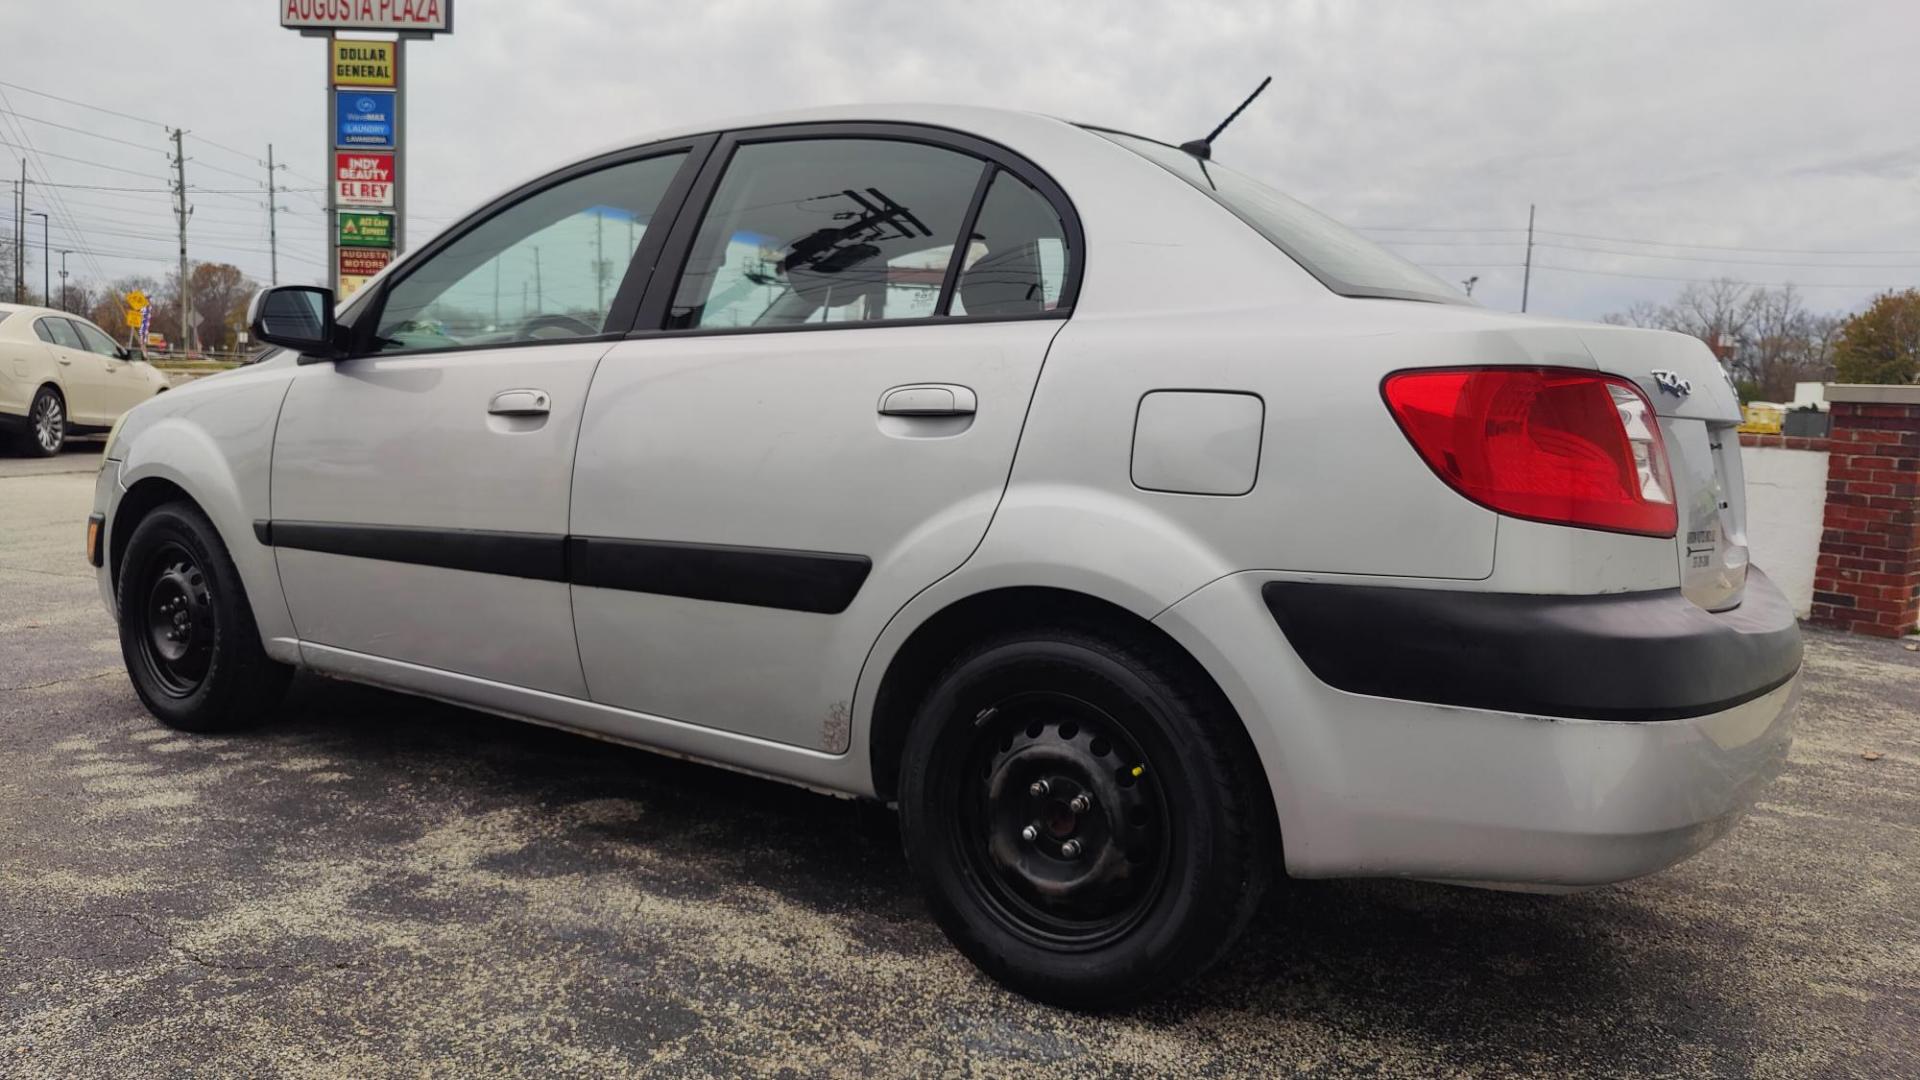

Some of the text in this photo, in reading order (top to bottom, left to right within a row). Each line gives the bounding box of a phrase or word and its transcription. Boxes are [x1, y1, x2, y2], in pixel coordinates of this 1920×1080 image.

[286, 0, 440, 23] AUGUSTA PLAZA
[340, 48, 387, 62] DOLLAR
[336, 64, 391, 79] GENERAL
[349, 158, 380, 169] INDY
[339, 168, 389, 180] BEAUTY
[341, 183, 388, 198] EL REY
[341, 250, 388, 259] AUGUSTA
[344, 260, 385, 269] MOTORS
